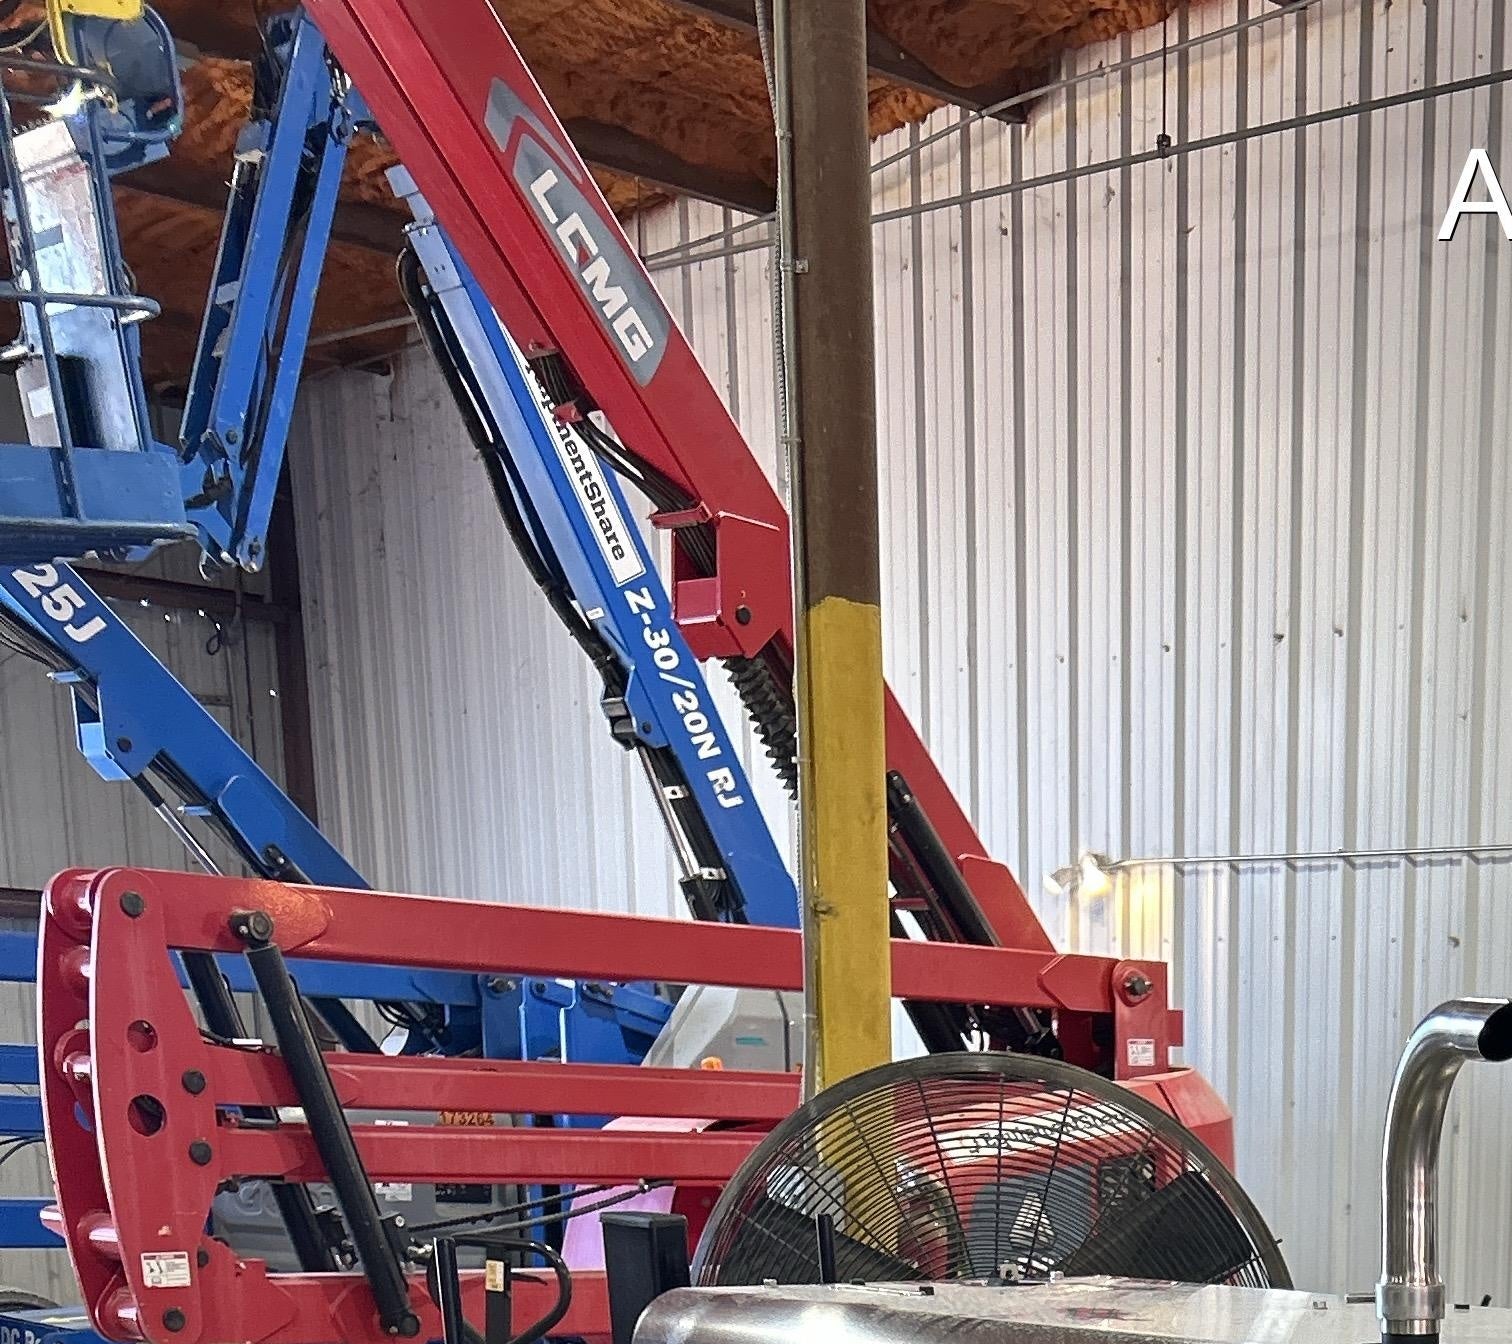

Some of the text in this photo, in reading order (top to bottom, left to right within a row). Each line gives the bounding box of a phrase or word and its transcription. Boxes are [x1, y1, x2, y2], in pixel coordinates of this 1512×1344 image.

[12, 563, 107, 643] 25J
[623, 586, 745, 809] Z-30/20N RJ
